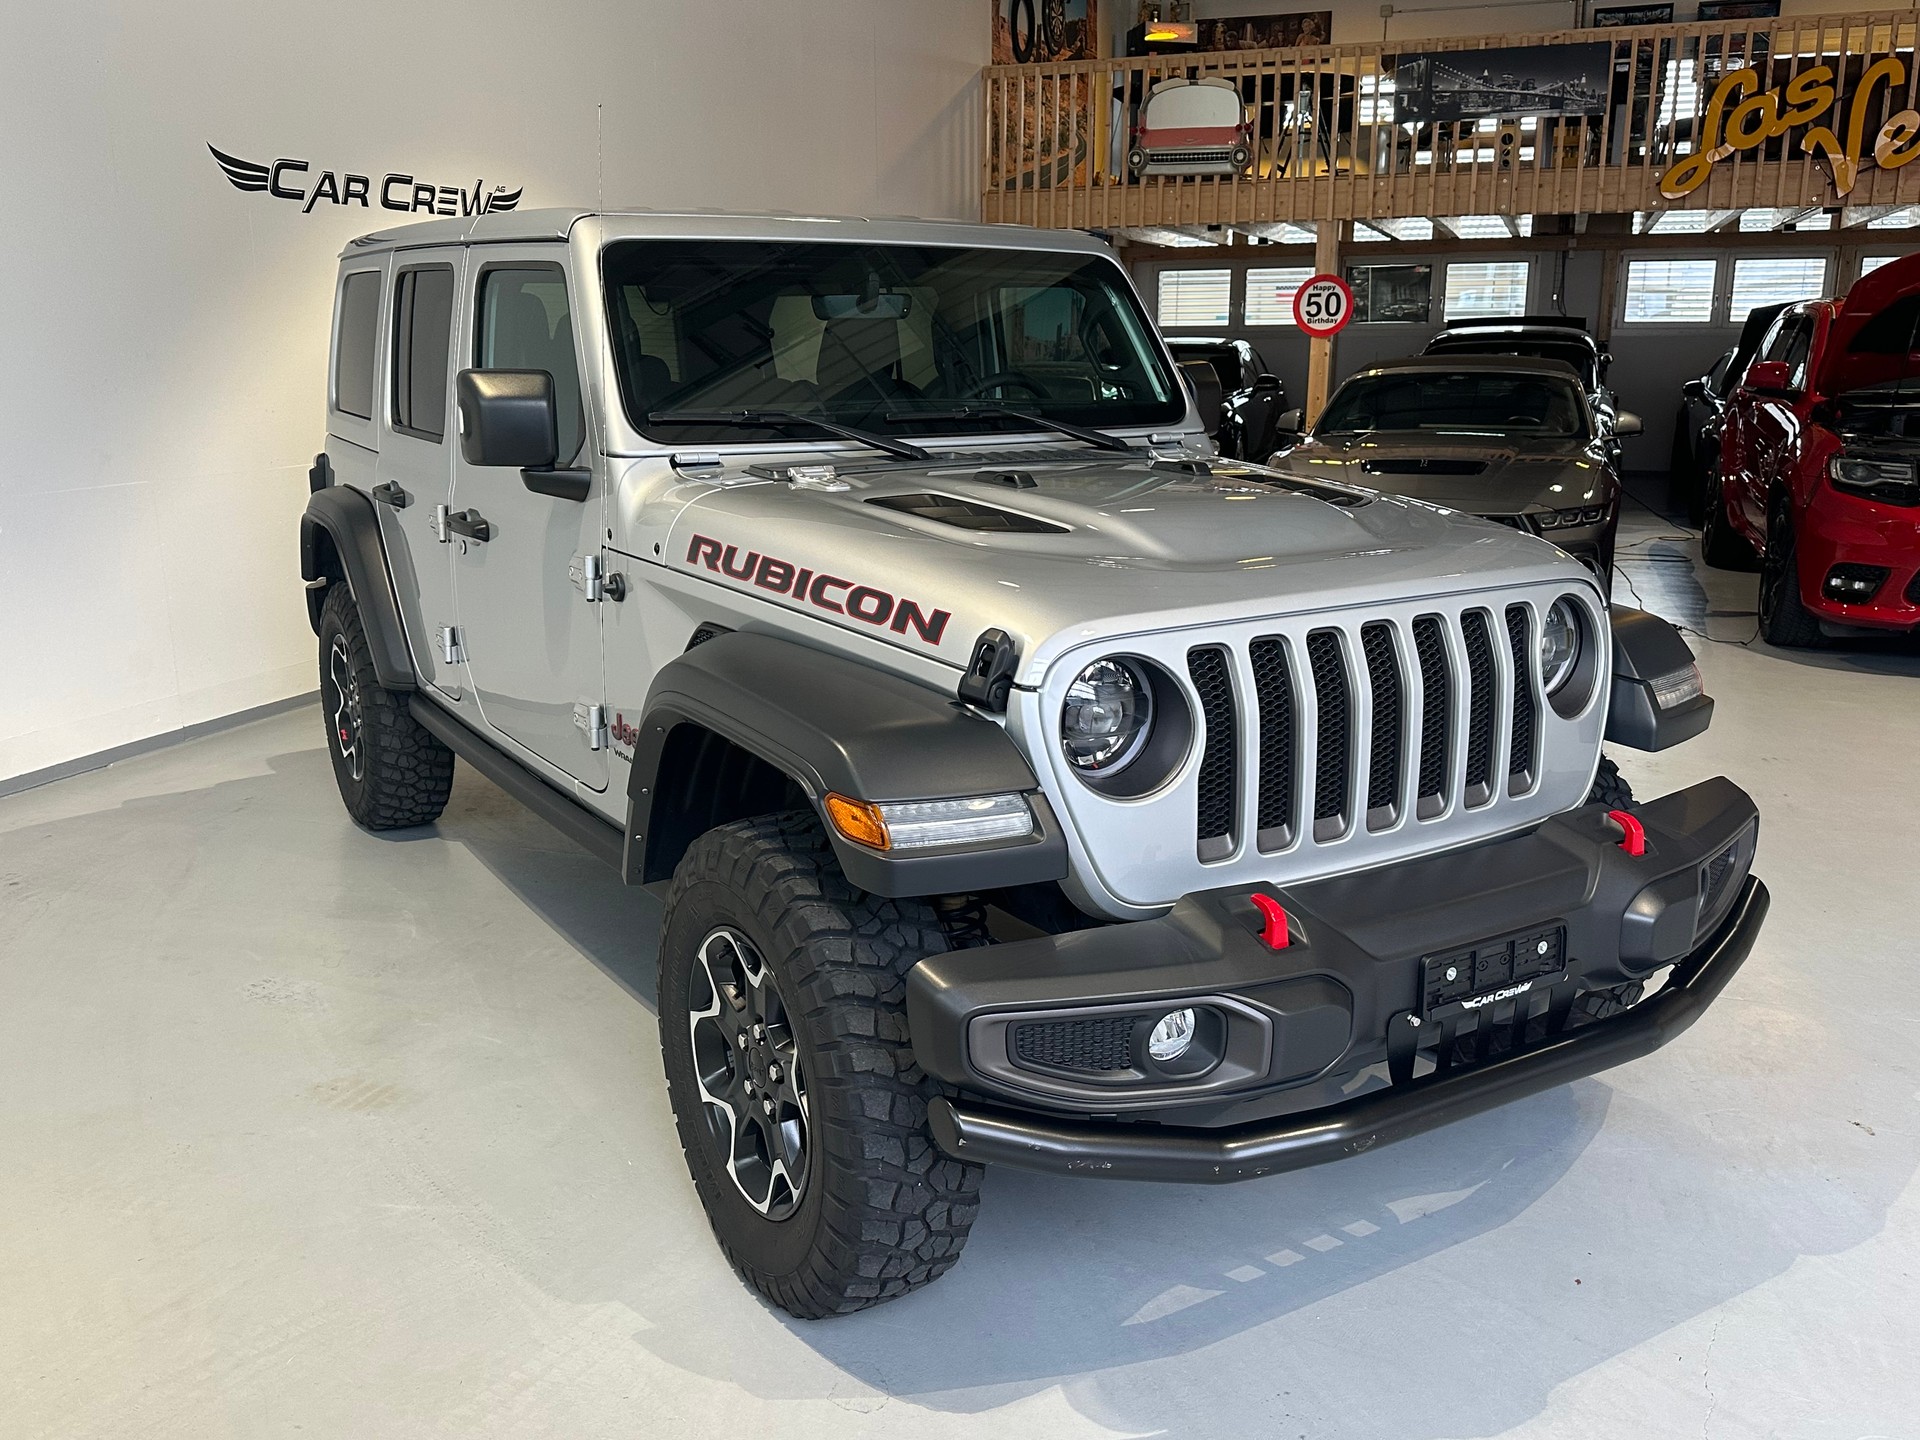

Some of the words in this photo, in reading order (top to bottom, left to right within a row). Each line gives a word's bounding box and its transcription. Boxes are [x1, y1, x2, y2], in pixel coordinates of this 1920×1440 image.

[1660, 65, 1835, 199] Las
[1312, 284, 1336, 292] Happy
[1305, 292, 1341, 317] 50
[1307, 316, 1339, 325] Birthday
[686, 533, 952, 646] RUBICON
[611, 712, 640, 749] Jee
